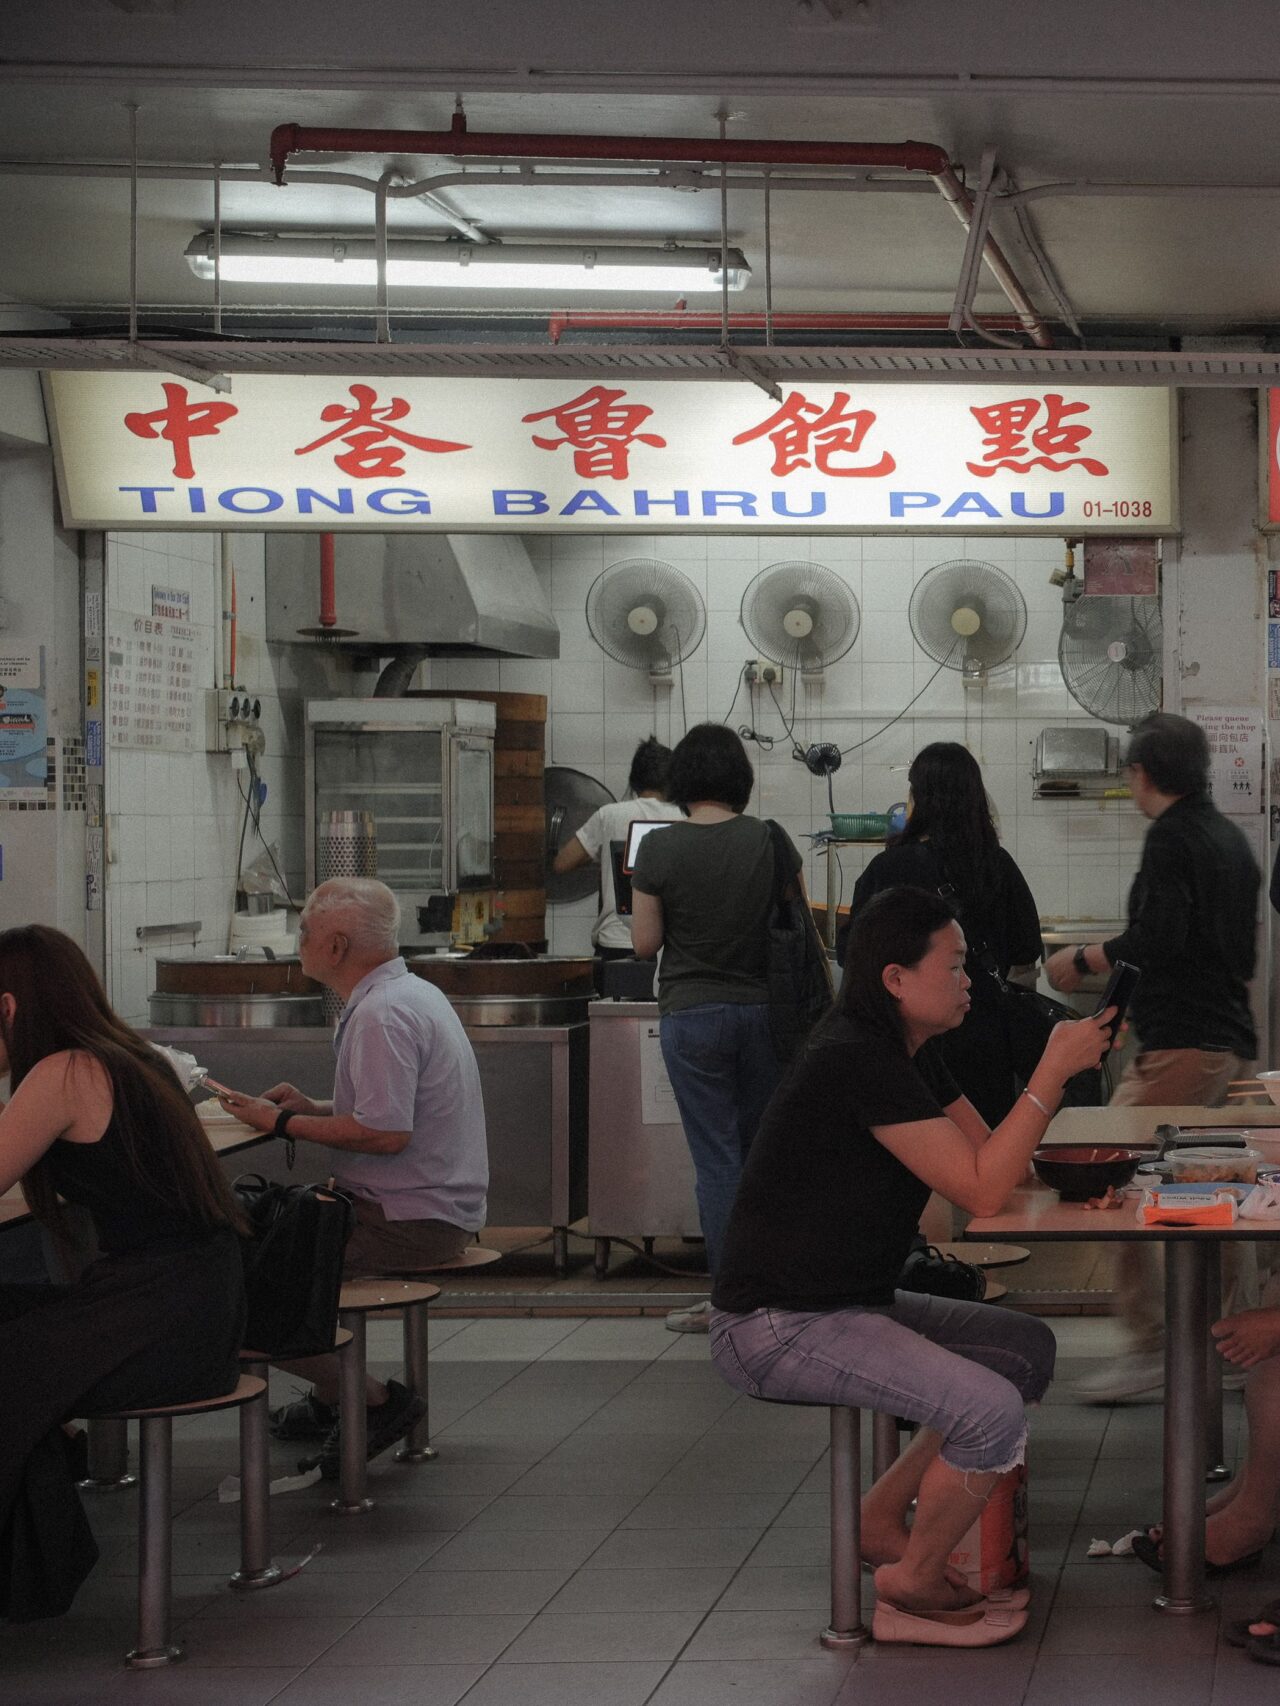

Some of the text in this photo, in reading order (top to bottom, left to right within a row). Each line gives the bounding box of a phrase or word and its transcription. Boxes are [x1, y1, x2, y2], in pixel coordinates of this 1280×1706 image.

[118, 486, 1065, 518] TIONG BAHRU PAU
[1083, 500, 1152, 518] 01-1038
[1201, 723, 1219, 731] cing
[1236, 723, 1256, 732] shop
